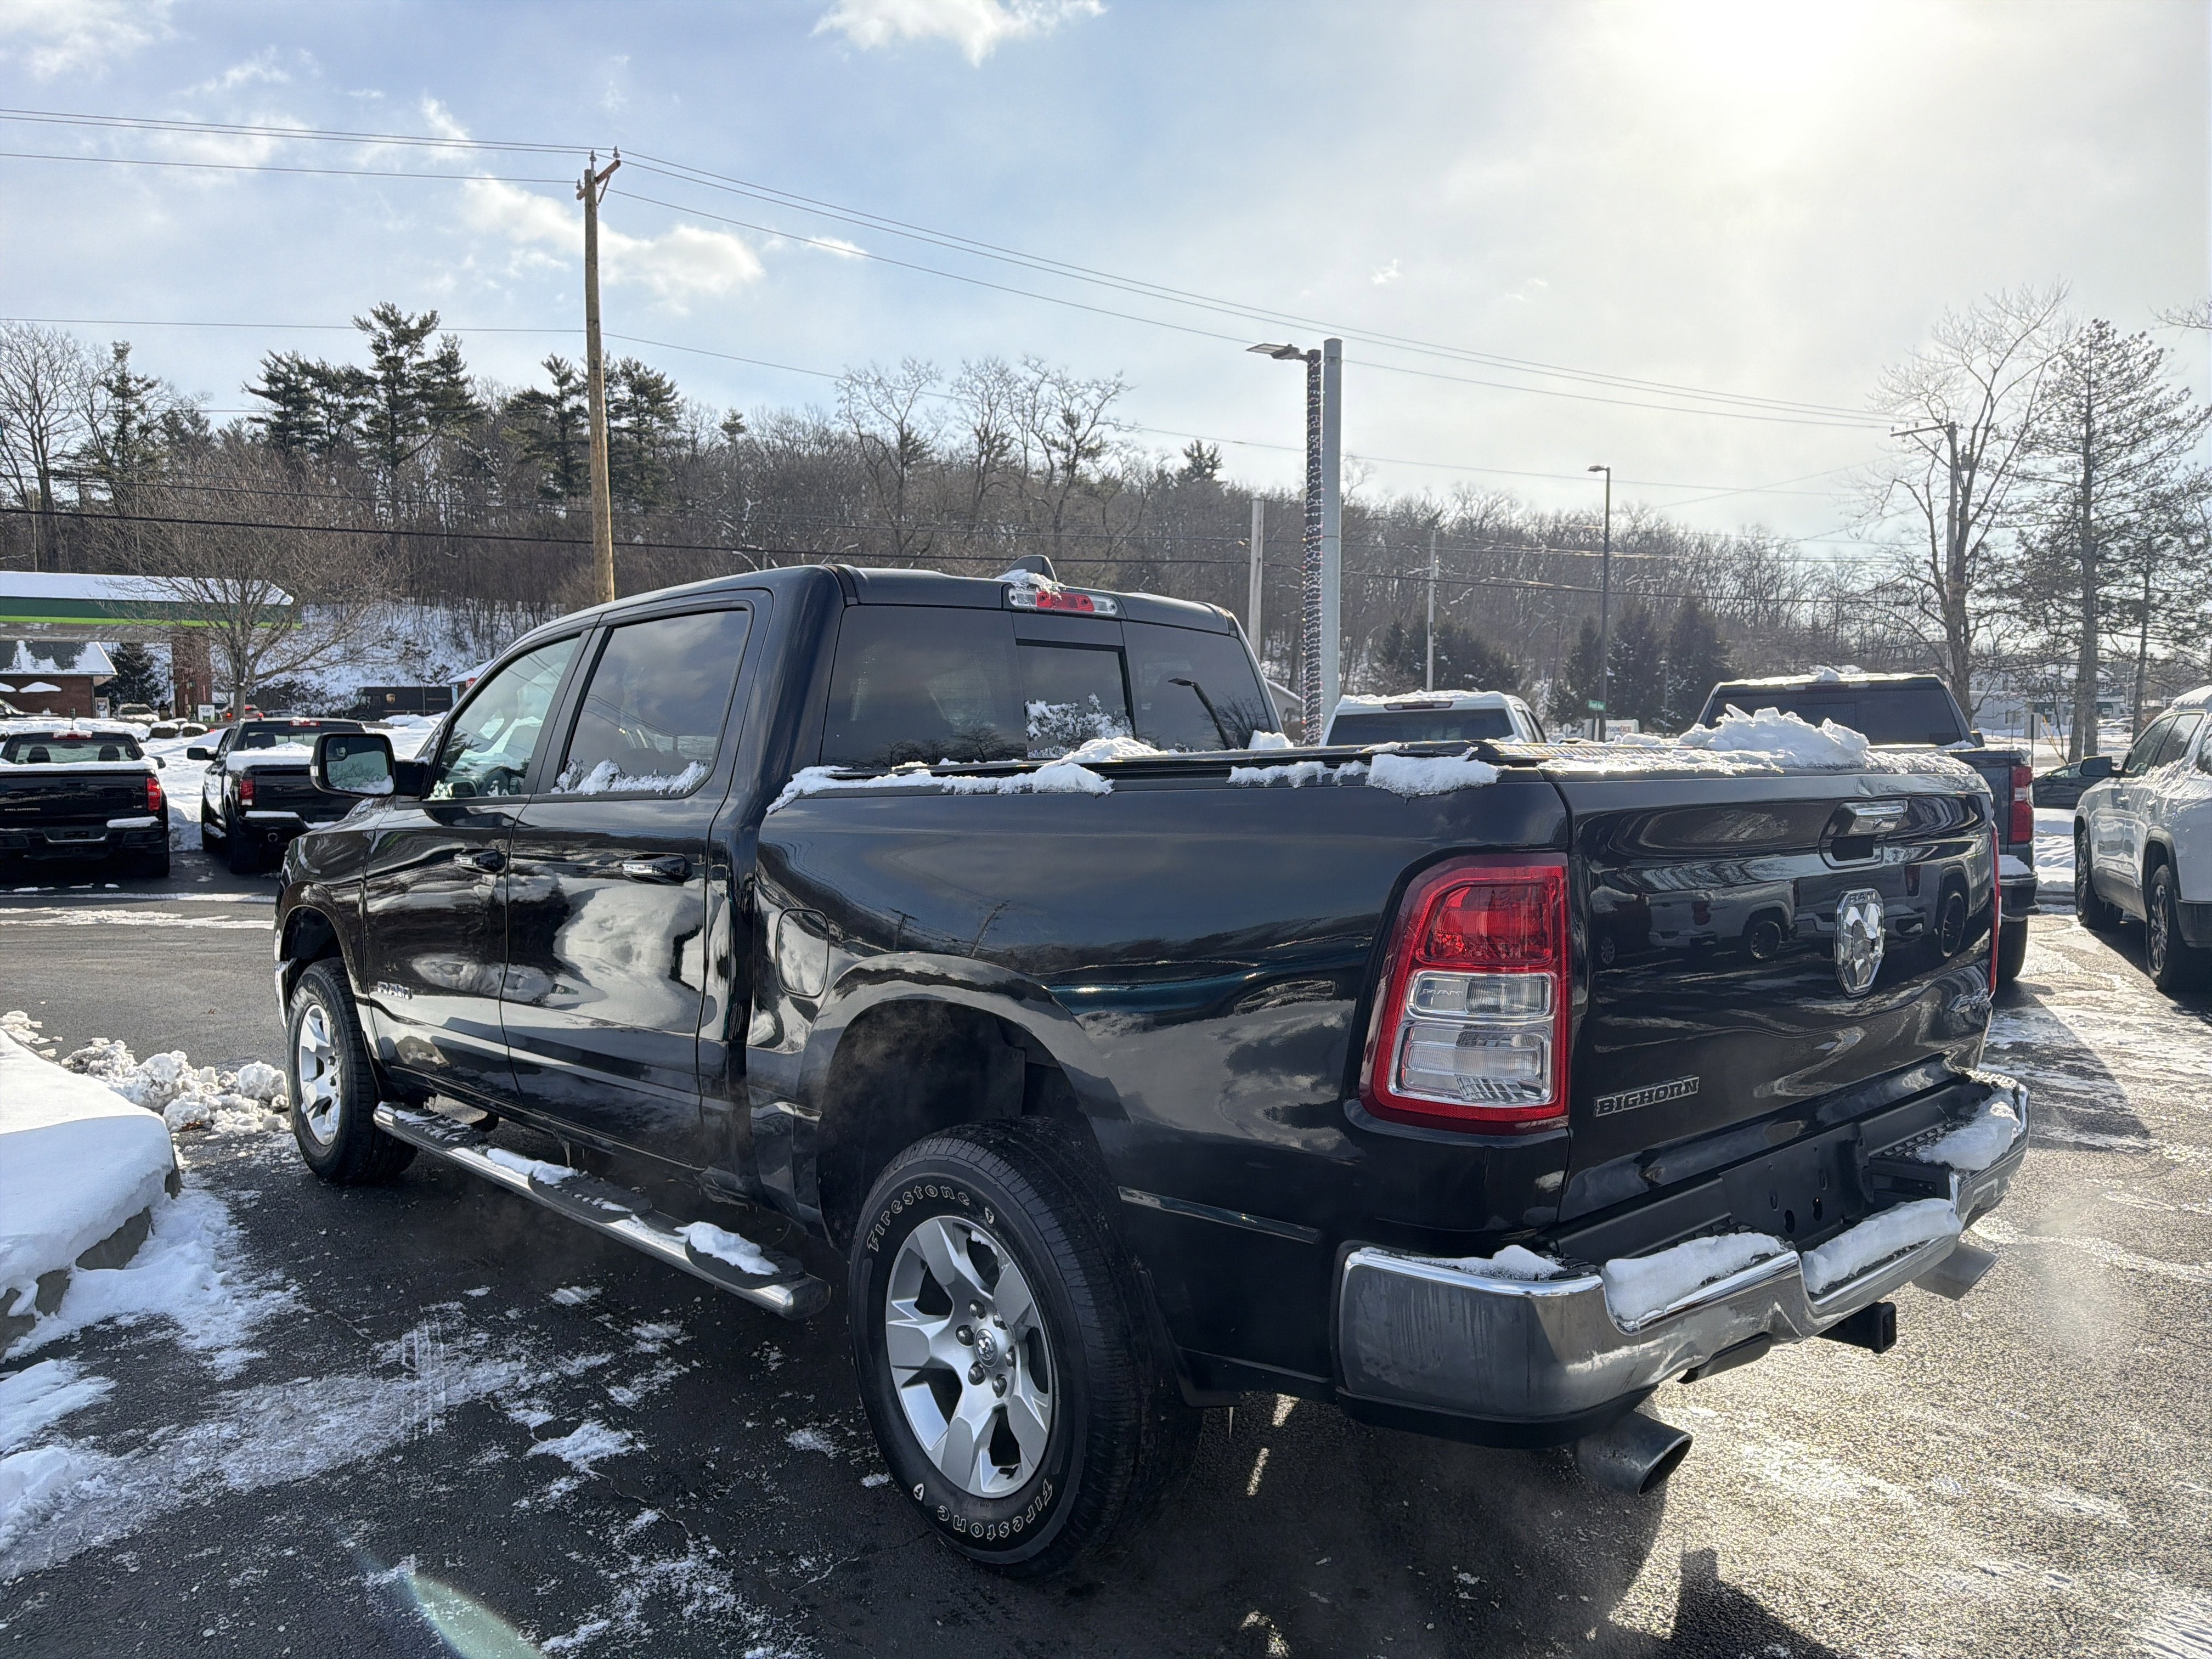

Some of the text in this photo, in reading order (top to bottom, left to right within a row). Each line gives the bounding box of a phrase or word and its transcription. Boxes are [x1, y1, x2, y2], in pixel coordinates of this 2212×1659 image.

[1849, 892, 1876, 904] RAM
[377, 981, 413, 1000] RAM
[866, 1184, 970, 1252] Firestone
[937, 1479, 1053, 1542] Firestone
